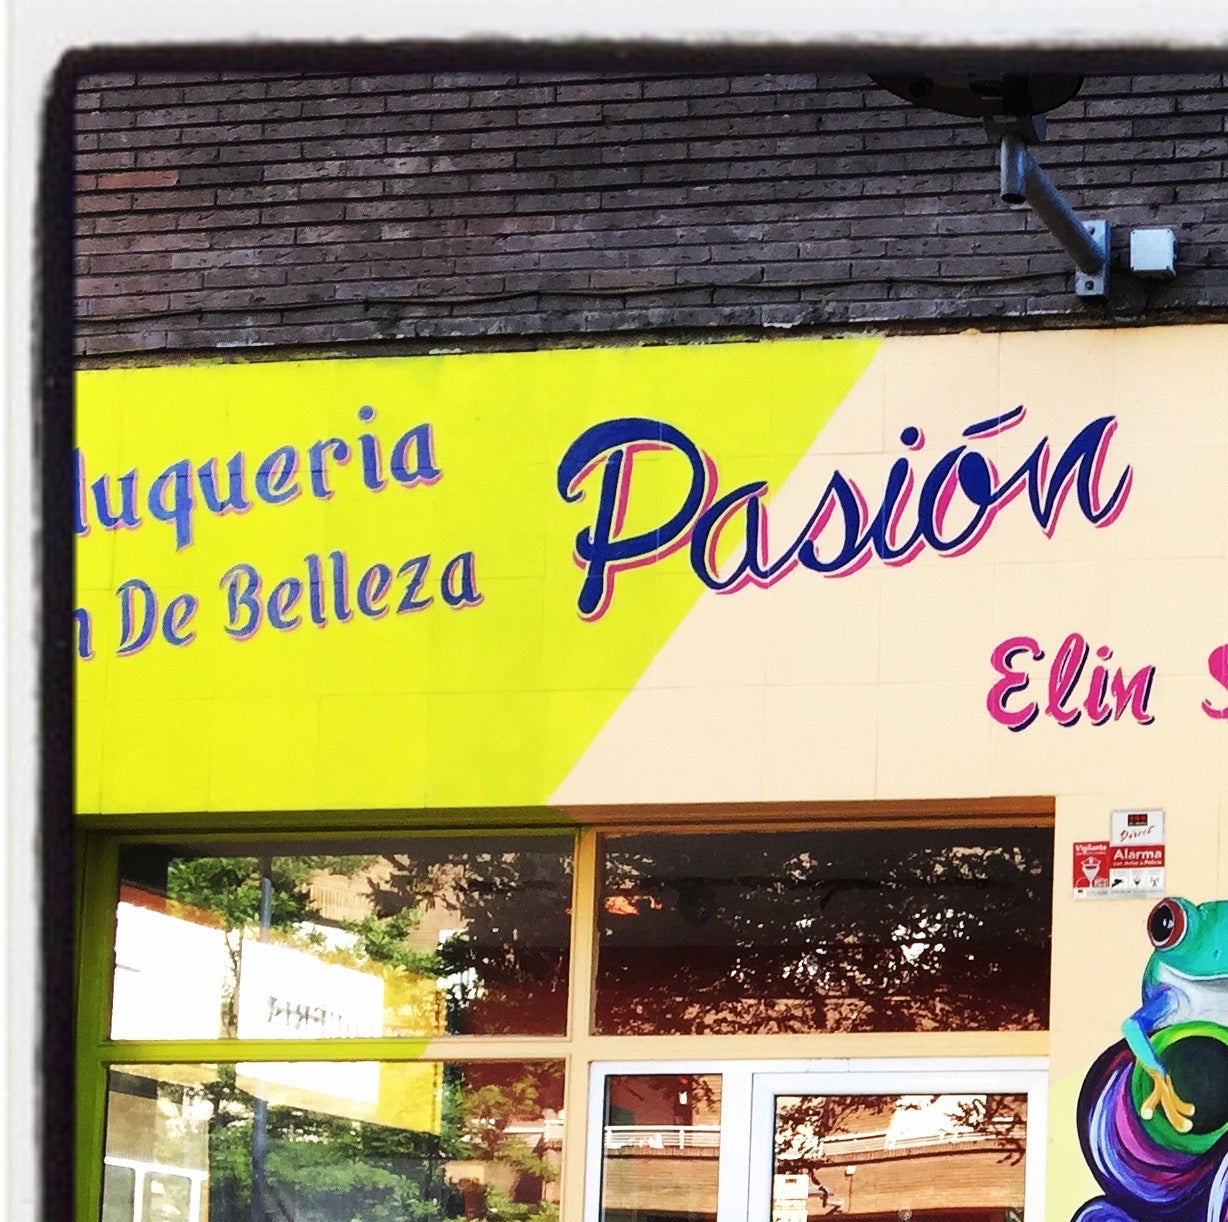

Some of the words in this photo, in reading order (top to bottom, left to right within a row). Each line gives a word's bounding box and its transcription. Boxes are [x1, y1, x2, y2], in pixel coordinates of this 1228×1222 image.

[557, 404, 1133, 623] Pasión
[115, 577, 197, 656] De
[218, 550, 484, 641] Belleza
[986, 632, 1155, 733] Elin
[1113, 847, 1163, 861] Alarma
